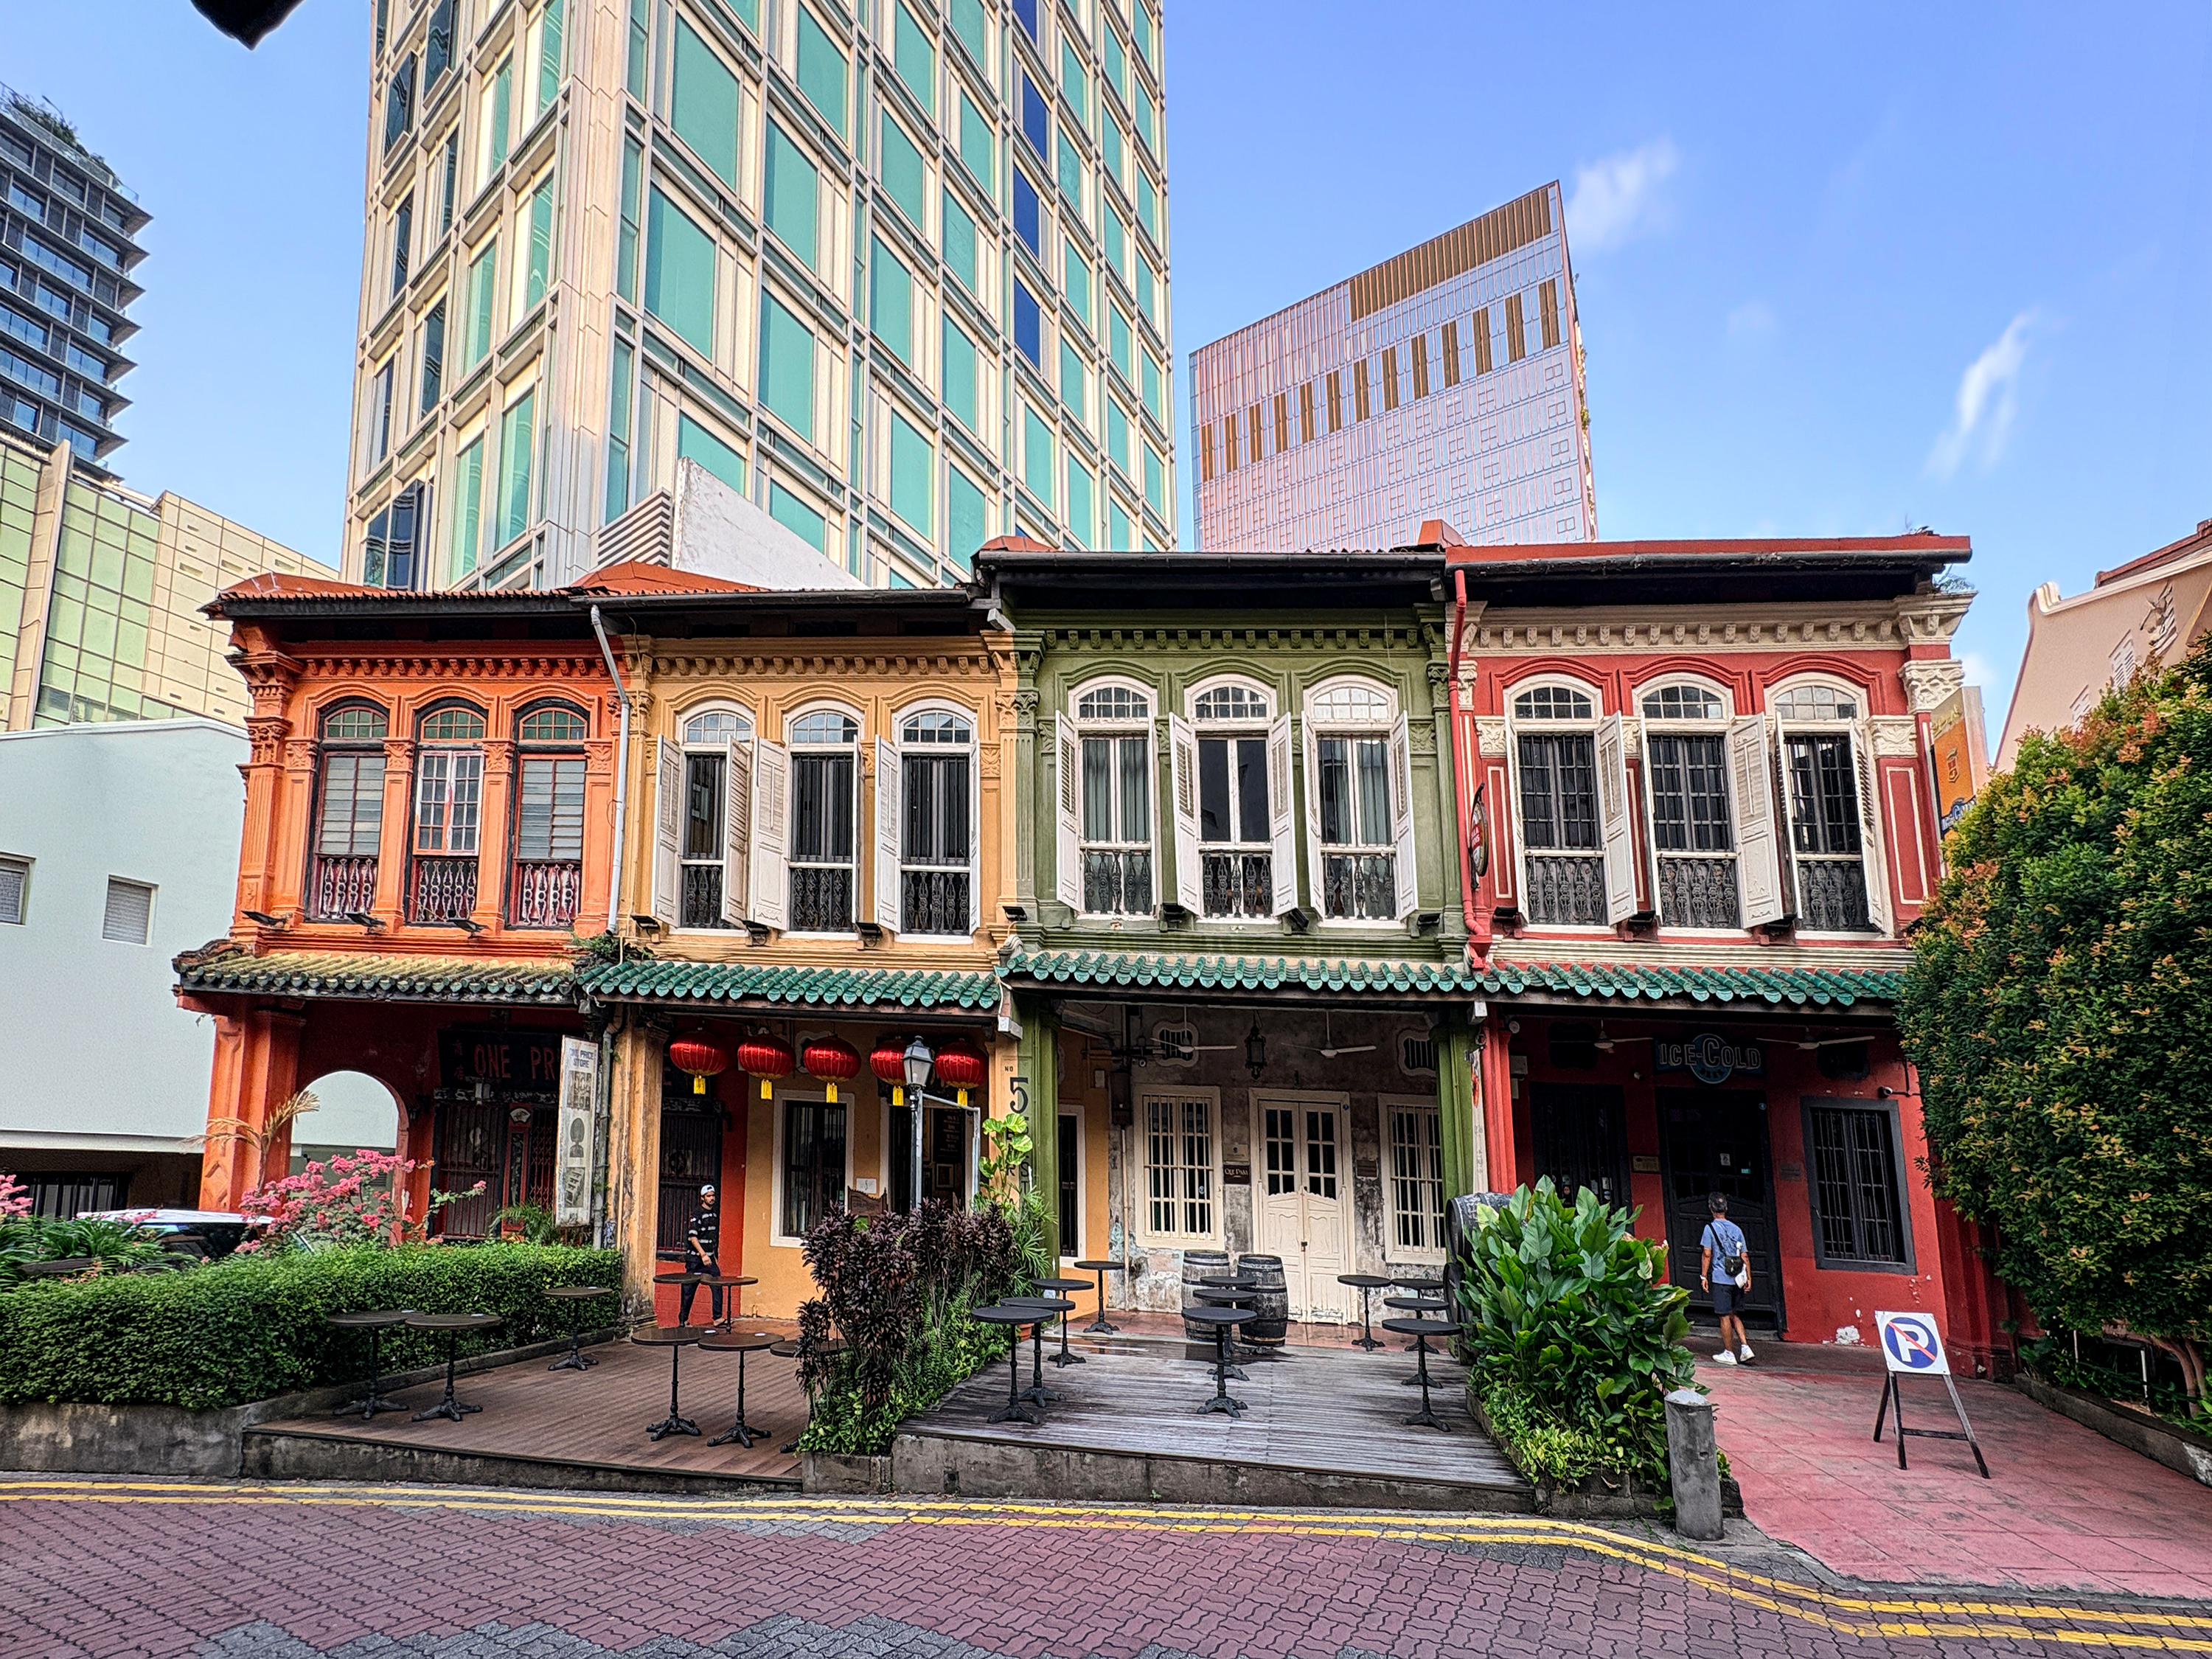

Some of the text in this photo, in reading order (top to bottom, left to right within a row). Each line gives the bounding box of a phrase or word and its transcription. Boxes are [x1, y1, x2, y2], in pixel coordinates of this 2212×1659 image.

[473, 1043, 557, 1081] ONE PR
[568, 1048, 594, 1060] ONE PRICE
[574, 1058, 590, 1068] STORE
[1659, 1037, 1761, 1070] ICE-COLD
[1009, 1077, 1029, 1113] 5
[1225, 1168, 1235, 1176] QUE
[1891, 1322, 1929, 1363] P
